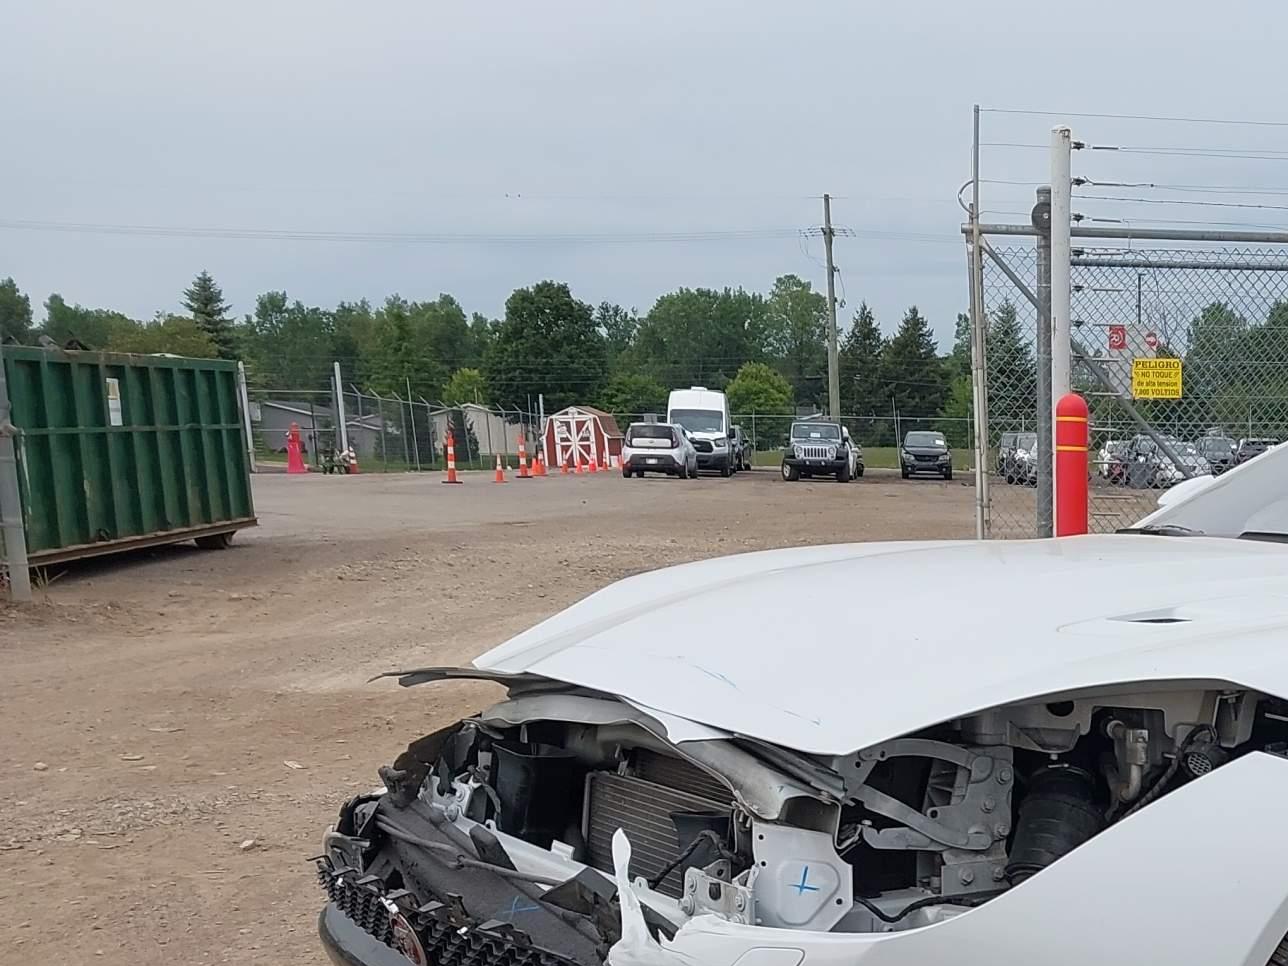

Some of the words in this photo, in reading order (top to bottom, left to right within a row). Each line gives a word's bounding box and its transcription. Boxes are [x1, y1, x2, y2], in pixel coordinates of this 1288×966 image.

[1135, 361, 1180, 369] PELIGRO
[1141, 371, 1151, 379] NO
[1152, 371, 1172, 379] TOQUE
